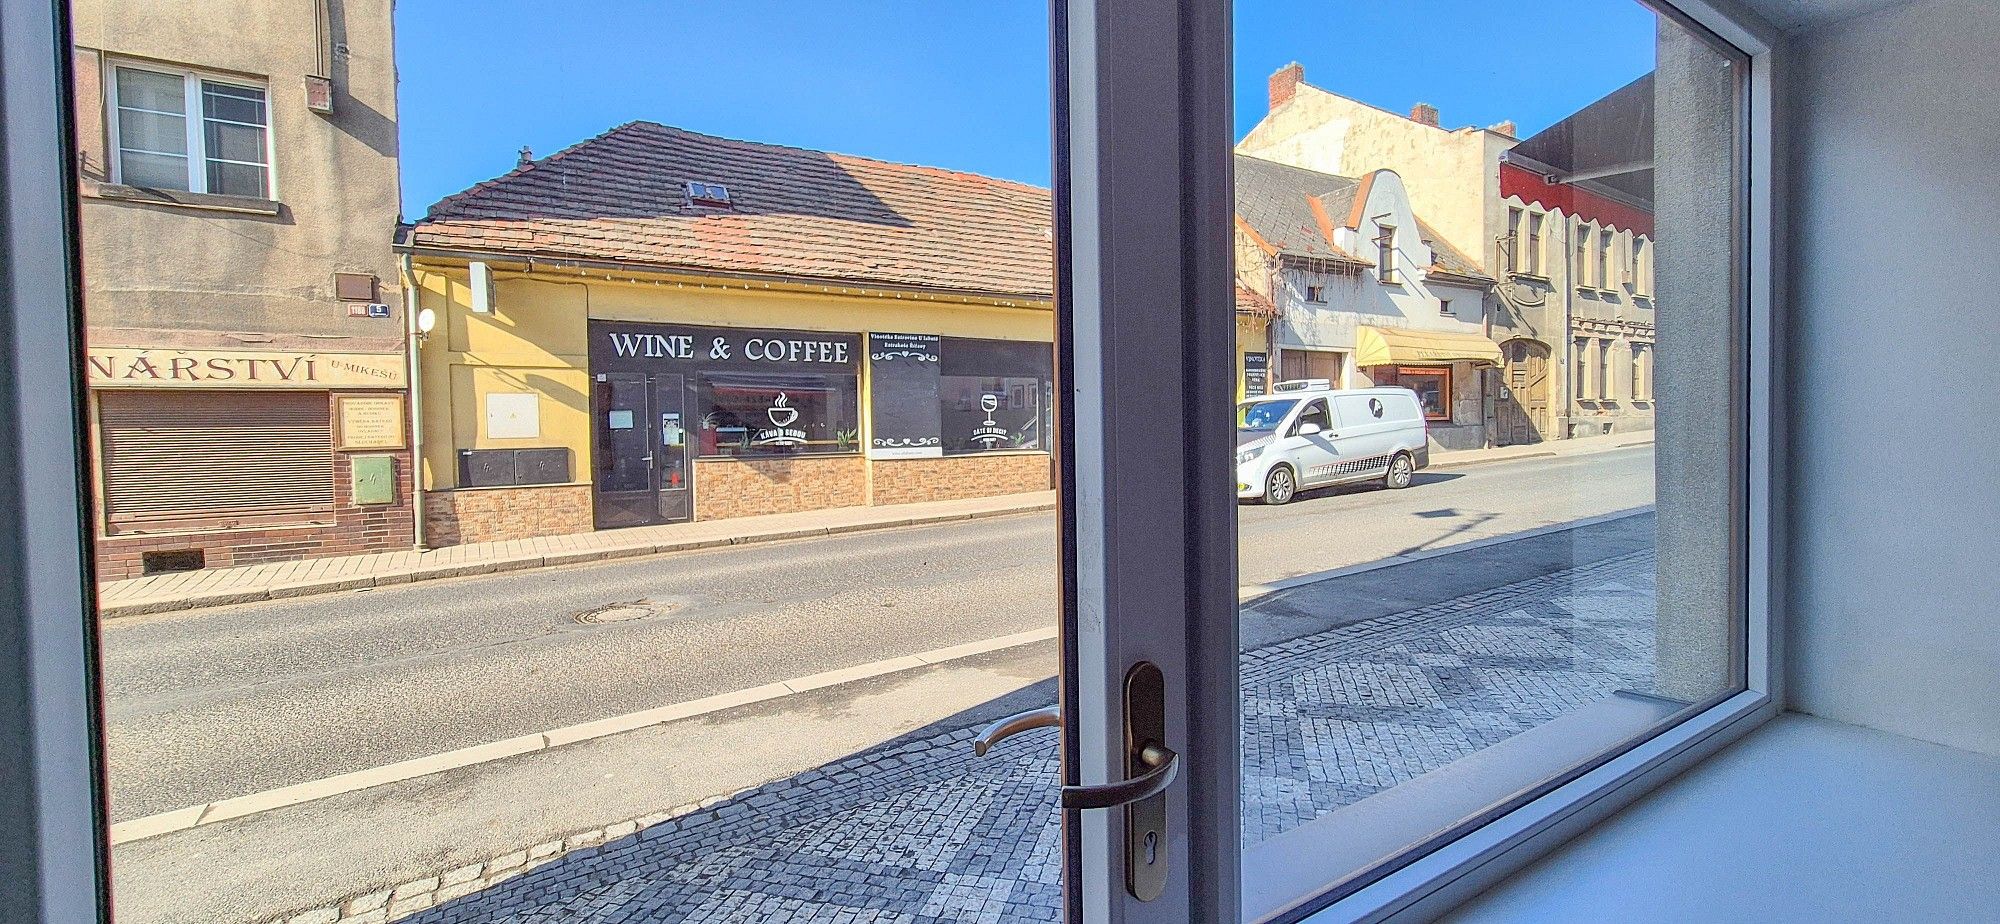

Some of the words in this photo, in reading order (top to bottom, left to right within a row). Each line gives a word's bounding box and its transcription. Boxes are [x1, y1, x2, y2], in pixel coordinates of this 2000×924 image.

[609, 332, 694, 359] WINE
[709, 336, 731, 360] &
[745, 338, 849, 364] COFFEE
[89, 351, 318, 382] NÁŘSTVÍ
[331, 360, 340, 368] U
